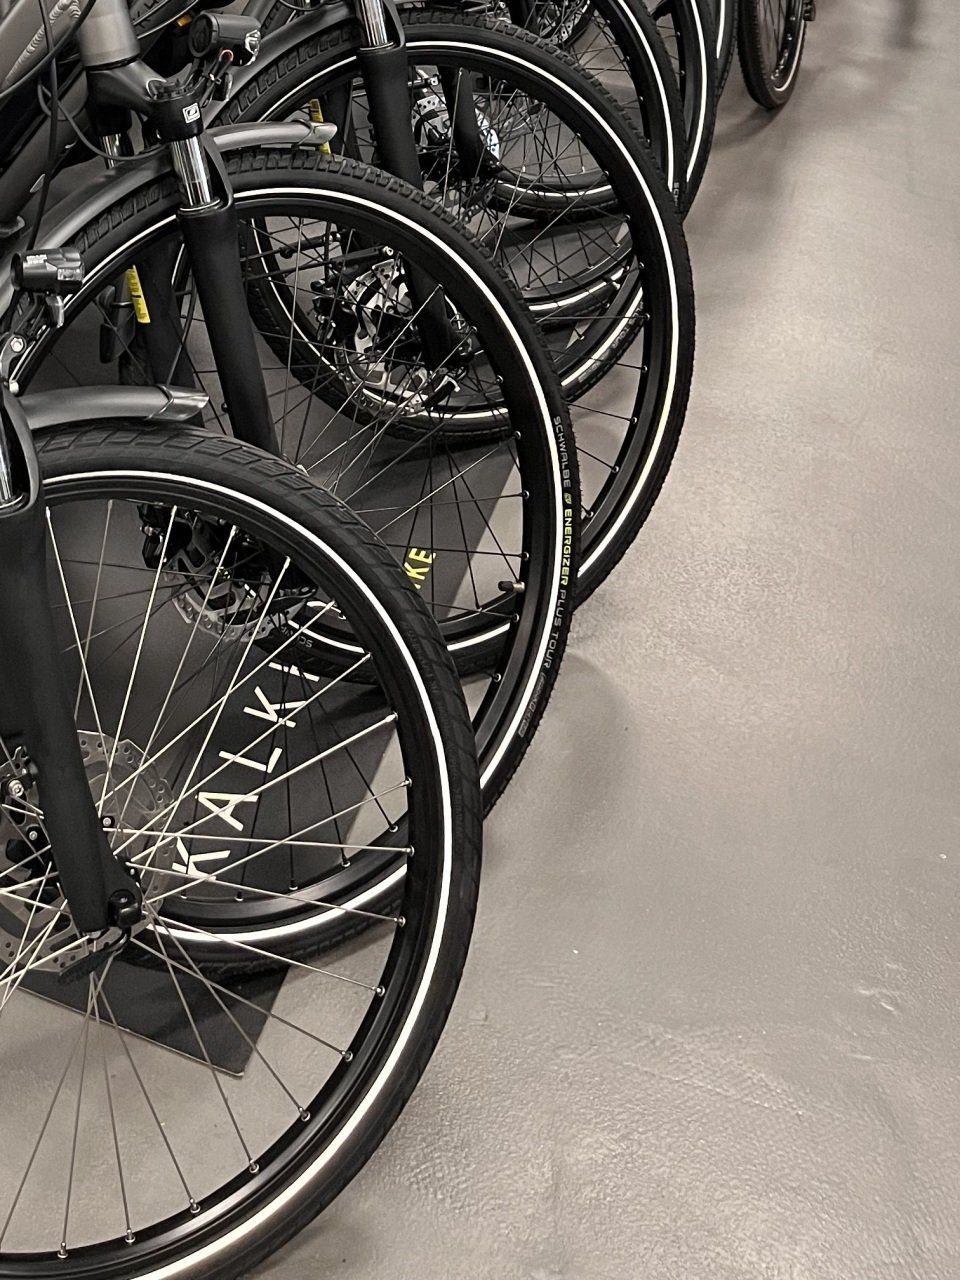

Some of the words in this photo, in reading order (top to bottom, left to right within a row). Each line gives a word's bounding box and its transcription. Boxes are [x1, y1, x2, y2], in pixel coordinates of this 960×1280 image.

[553, 415, 572, 489] SCHWALBE
[560, 507, 573, 587] ENERGIZER
[551, 587, 568, 635] PLUS
[543, 630, 560, 671] TOUR
